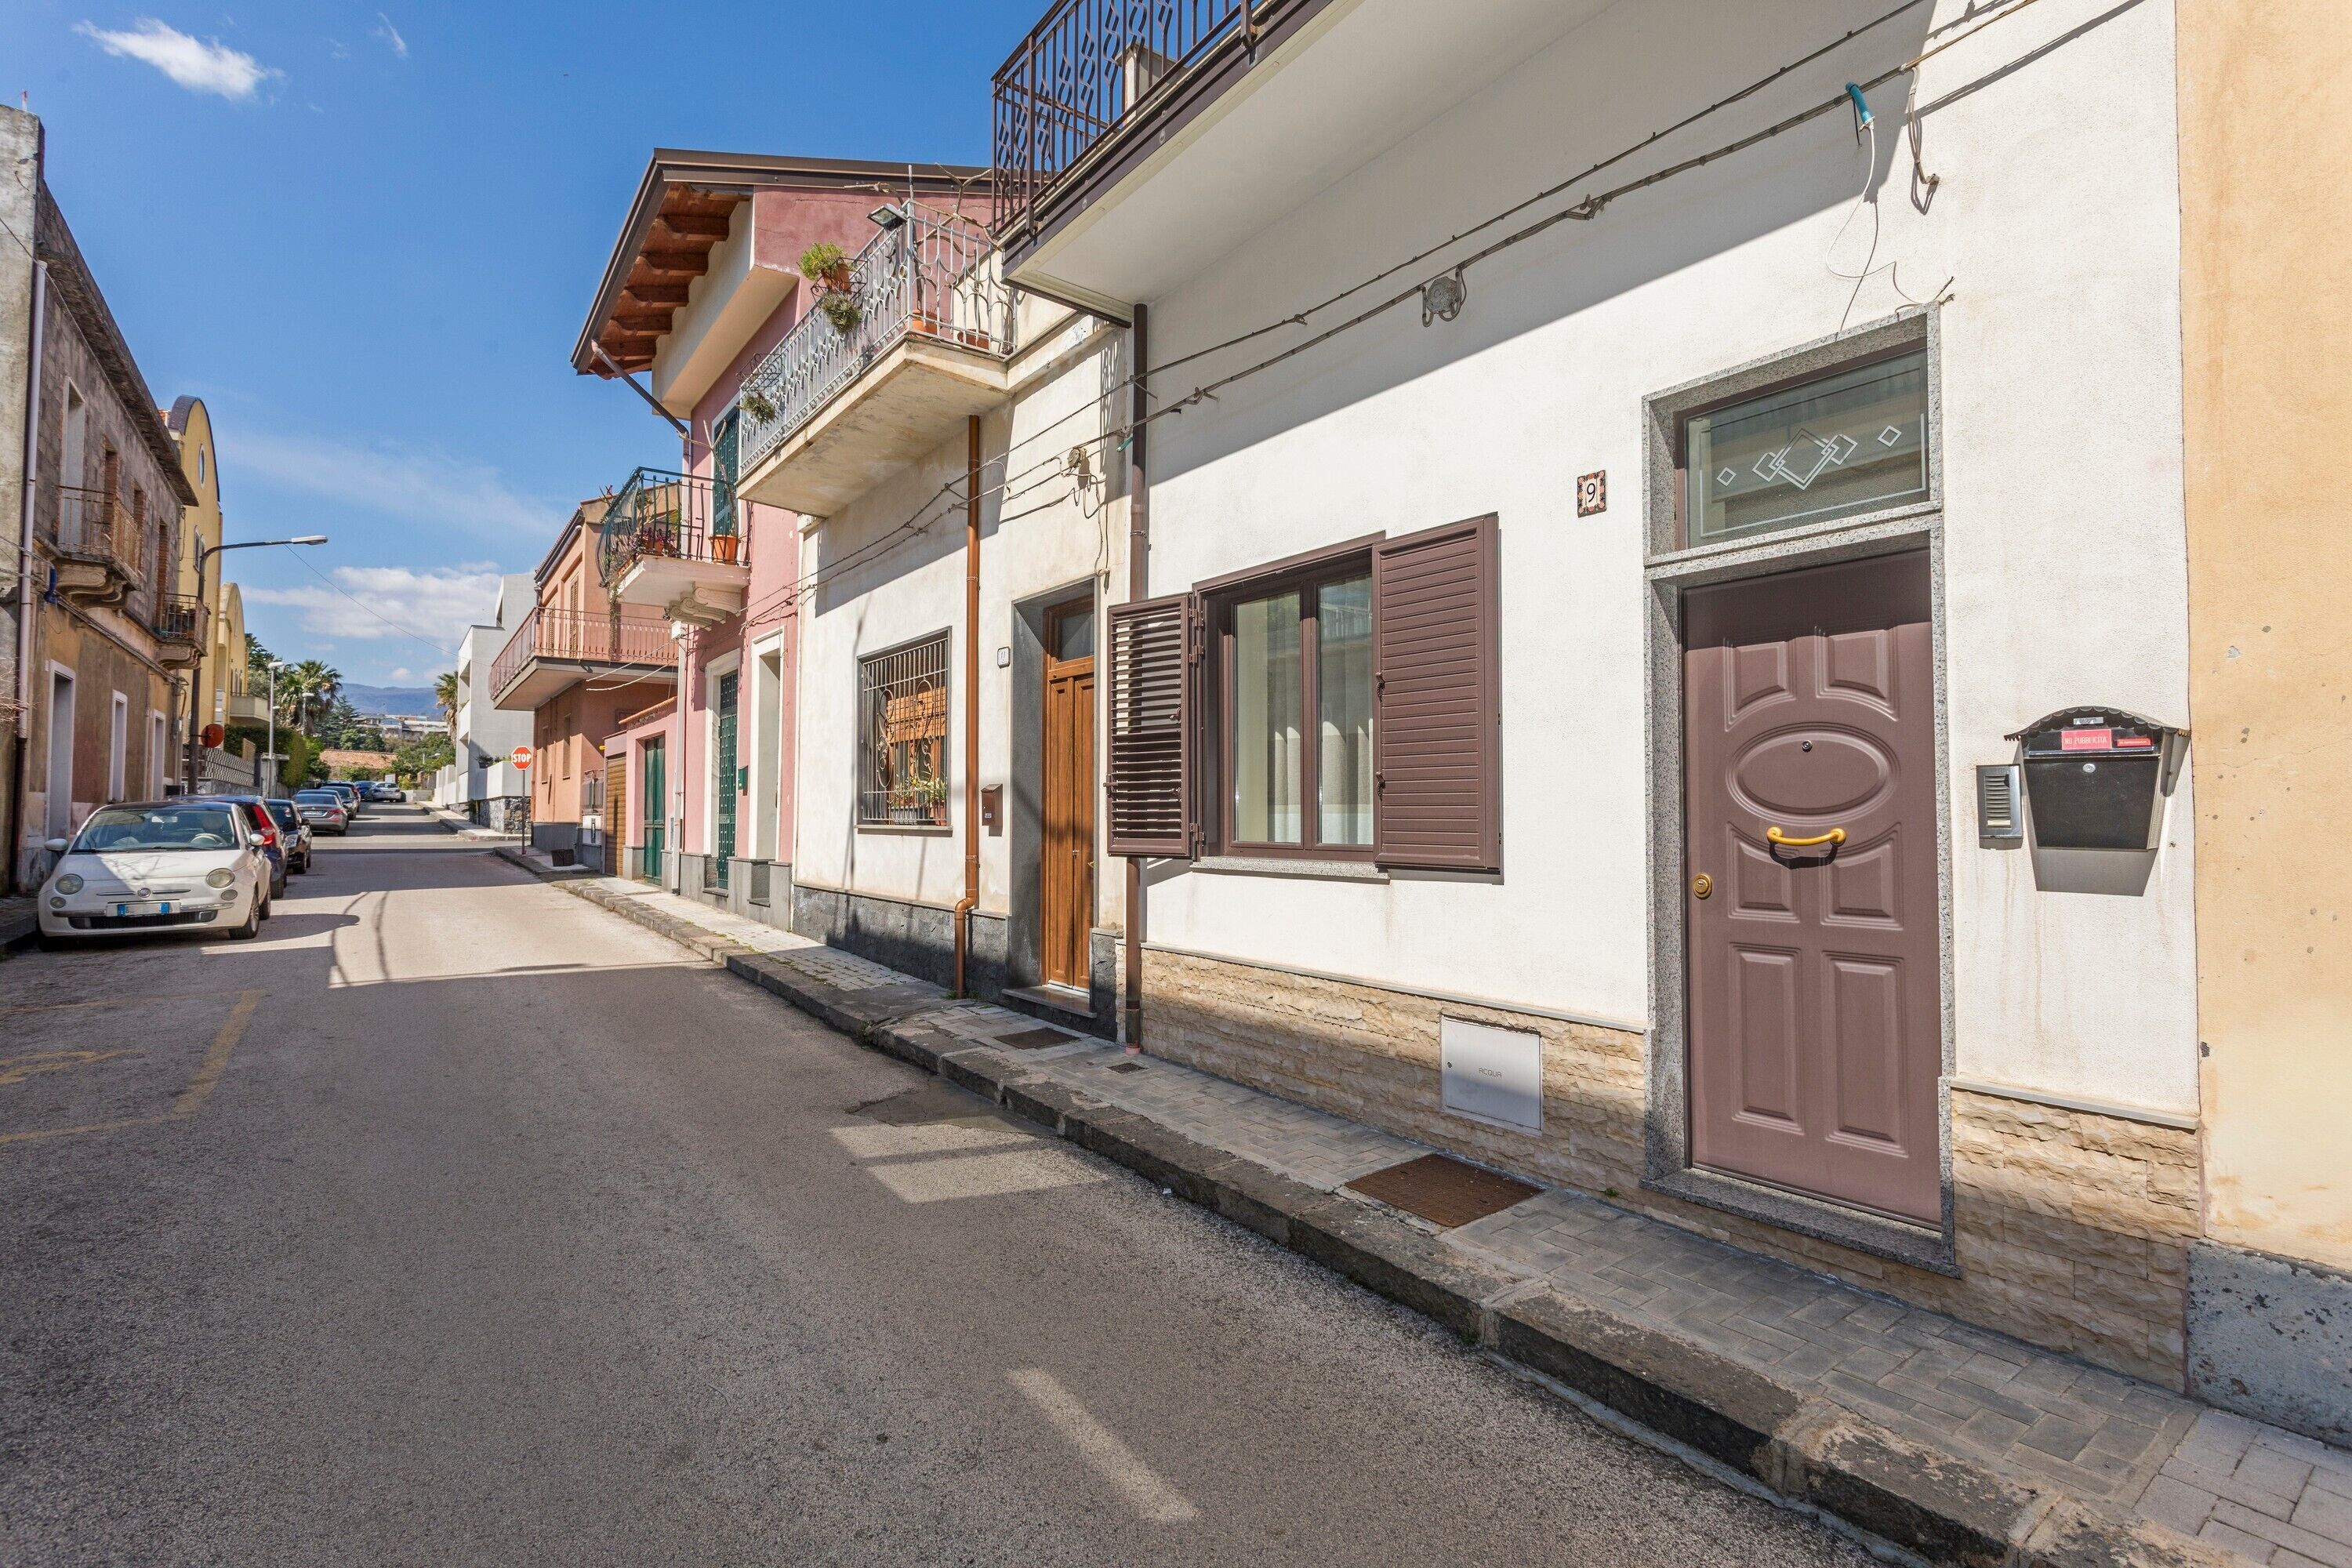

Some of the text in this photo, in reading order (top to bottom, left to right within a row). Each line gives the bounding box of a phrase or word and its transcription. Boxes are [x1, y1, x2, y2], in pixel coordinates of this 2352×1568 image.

[1587, 483, 1596, 503] 9
[512, 753, 532, 763] STOP
[1479, 1068, 1502, 1078] ACQUA
